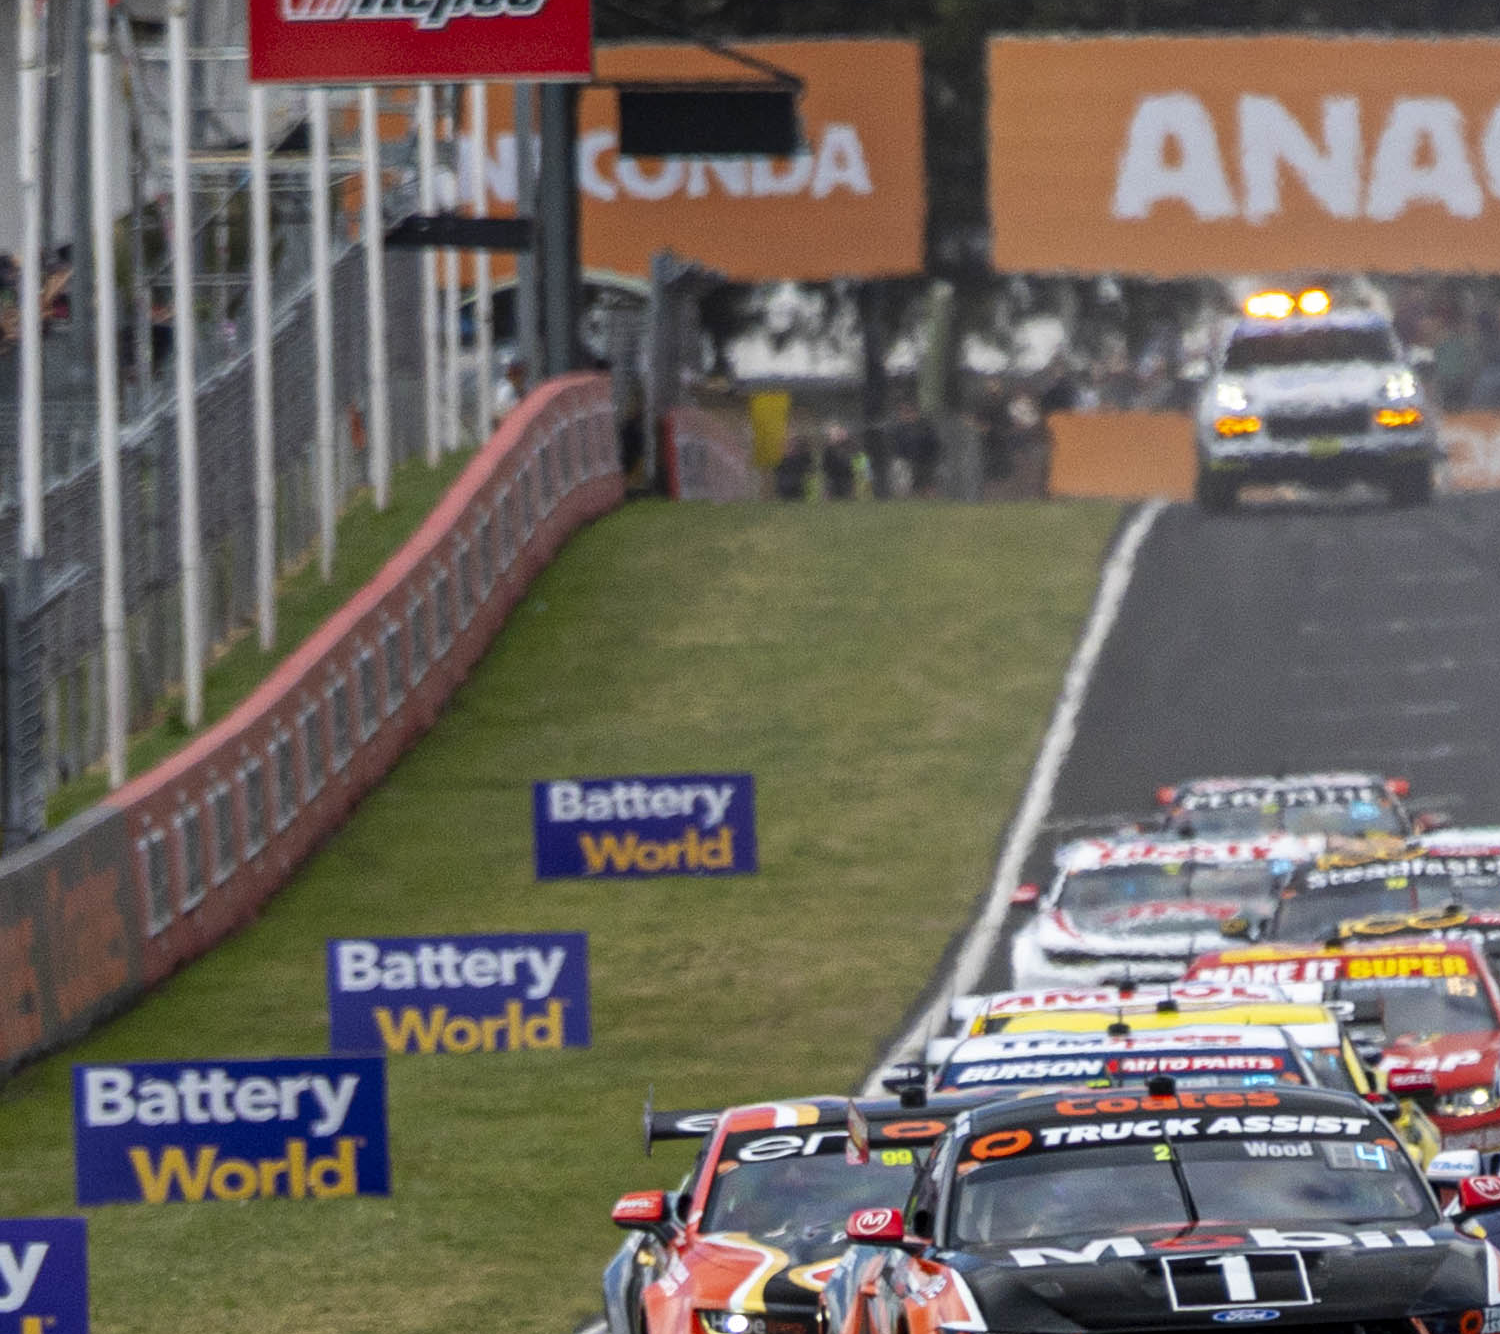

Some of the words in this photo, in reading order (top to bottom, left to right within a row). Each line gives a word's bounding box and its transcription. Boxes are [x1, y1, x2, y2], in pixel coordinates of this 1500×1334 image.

[547, 778, 734, 822] Battery
[580, 827, 734, 873] World
[337, 939, 566, 999] Battery
[1347, 955, 1470, 979] SUPER
[375, 1000, 565, 1055] World
[956, 1058, 1105, 1084] BURSON
[1193, 1055, 1276, 1071] PARTS
[83, 1067, 361, 1136] Battery
[1040, 1117, 1202, 1147] TRUCK
[1205, 1114, 1371, 1136] ASSIST
[1243, 1141, 1314, 1158] Wood
[129, 1139, 358, 1204] World
[1205, 1254, 1257, 1302] 1
